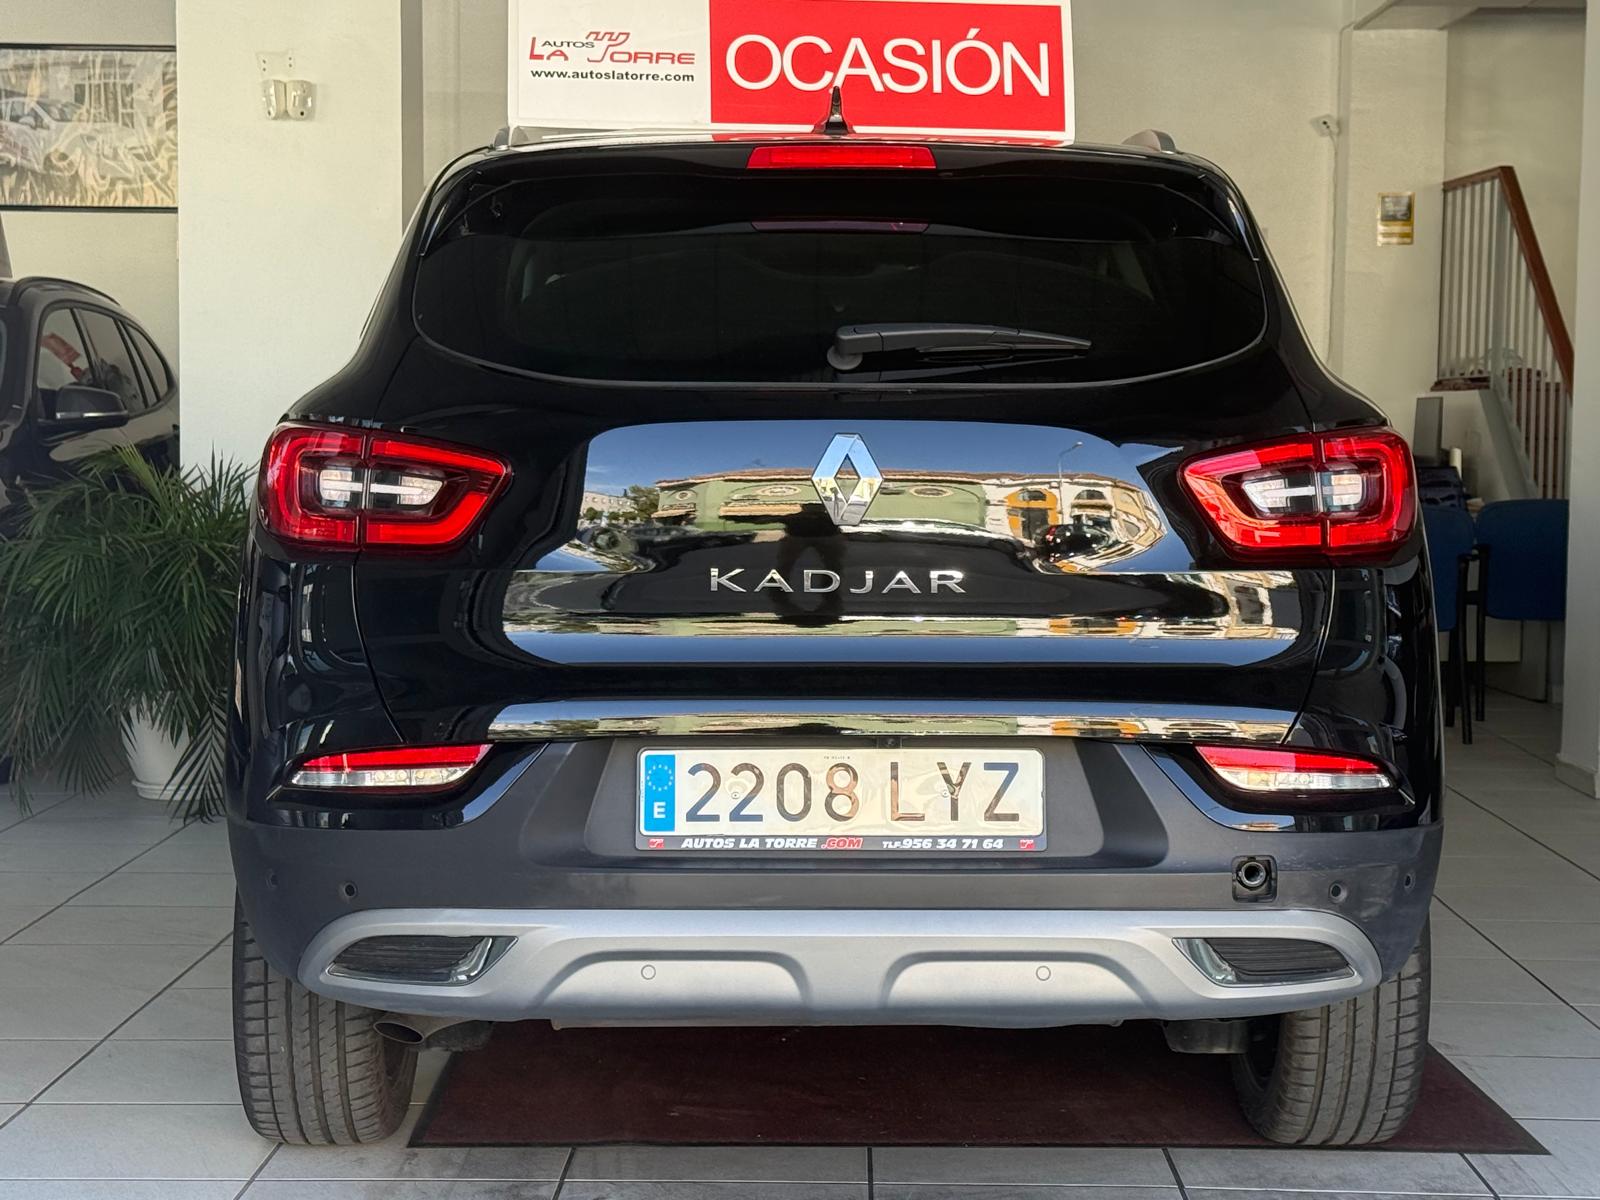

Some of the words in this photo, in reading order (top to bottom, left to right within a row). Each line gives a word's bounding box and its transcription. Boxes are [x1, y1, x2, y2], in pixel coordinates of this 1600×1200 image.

[529, 36, 570, 61] LA
[541, 40, 596, 49] AUTOS
[725, 27, 1051, 97] OCASIÓN
[530, 69, 695, 82] www.autoslatorre.com
[709, 567, 967, 594] KADJAR
[685, 762, 860, 823] 2208
[889, 761, 1021, 823] LYZ
[653, 801, 666, 819] E
[681, 838, 735, 849] AUTOS
[739, 838, 761, 849] LA
[765, 838, 818, 849] TORRE
[821, 837, 864, 850] .COM
[935, 838, 957, 849] 34
[961, 838, 978, 849] 71
[982, 838, 1004, 849] 64
